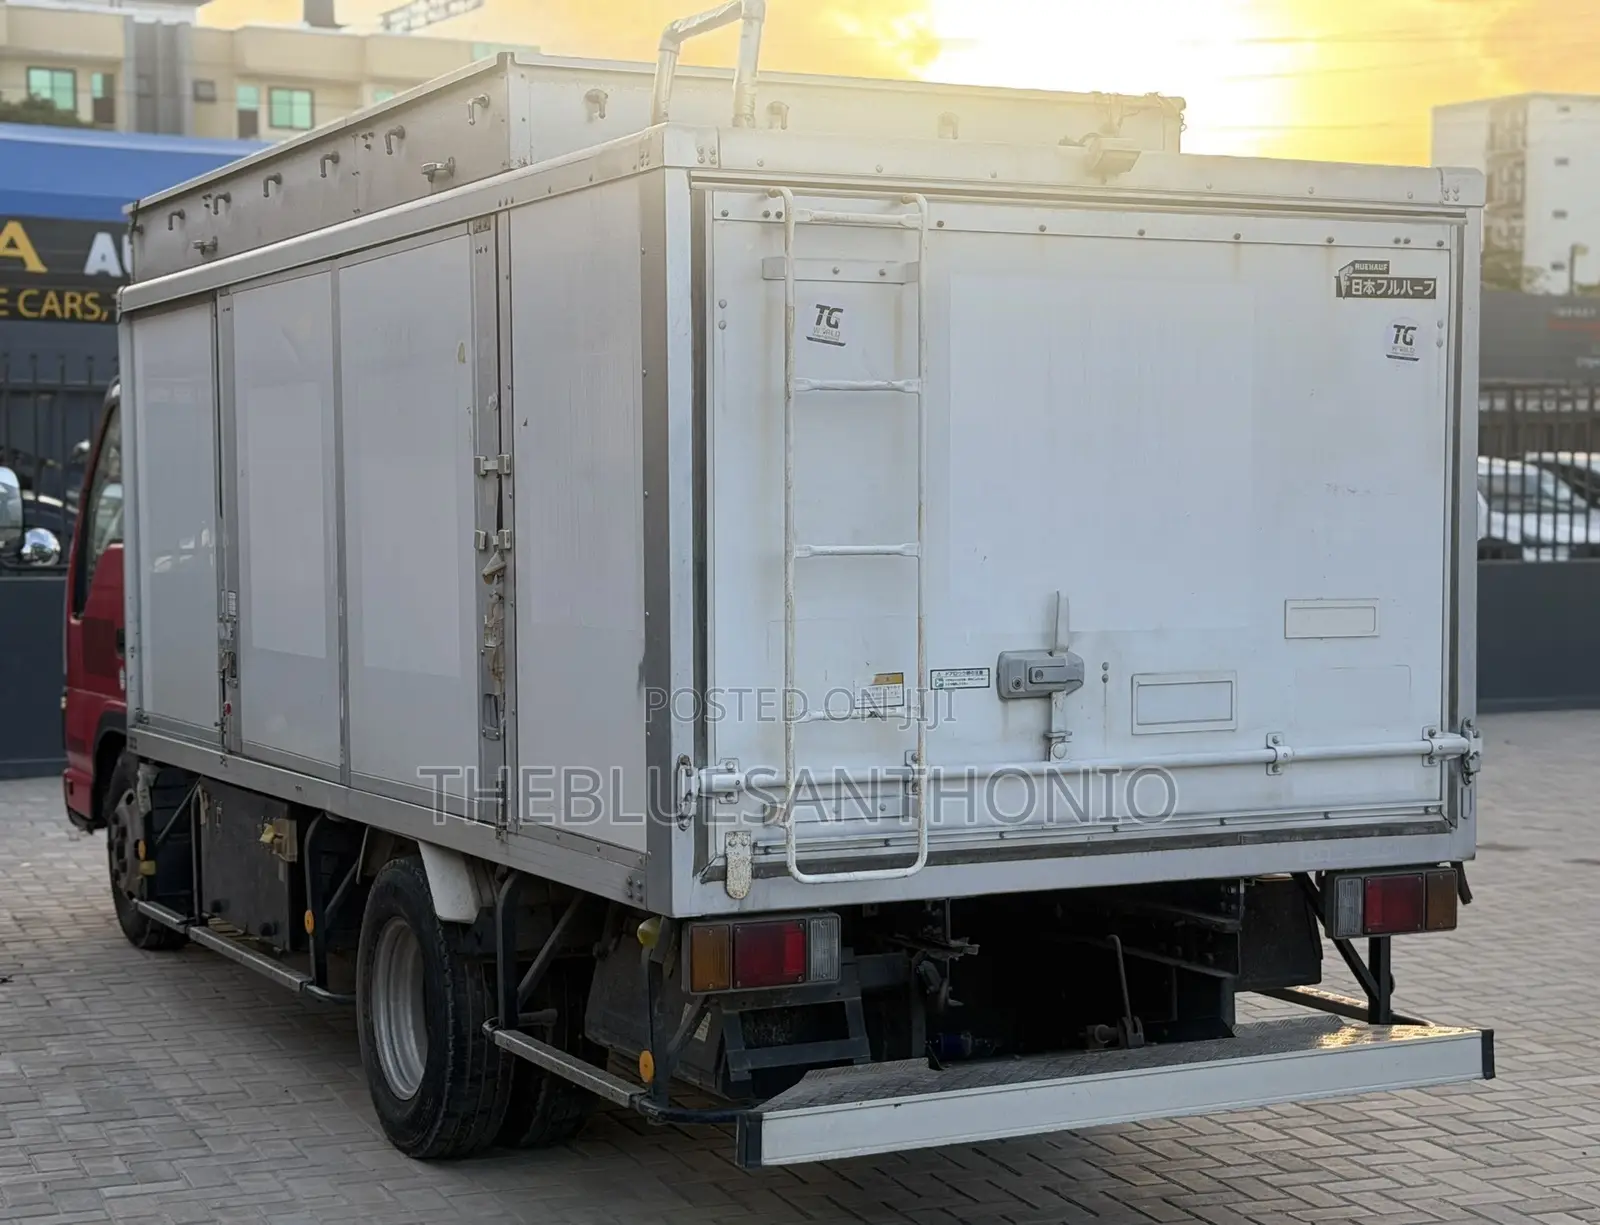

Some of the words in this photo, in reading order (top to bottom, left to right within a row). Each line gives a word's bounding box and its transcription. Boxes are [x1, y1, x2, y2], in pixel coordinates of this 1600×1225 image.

[1351, 278, 1435, 296] 日本フルハーフ
[17, 289, 108, 322] CARS,
[815, 303, 844, 329] TG
[1393, 324, 1417, 346] TG
